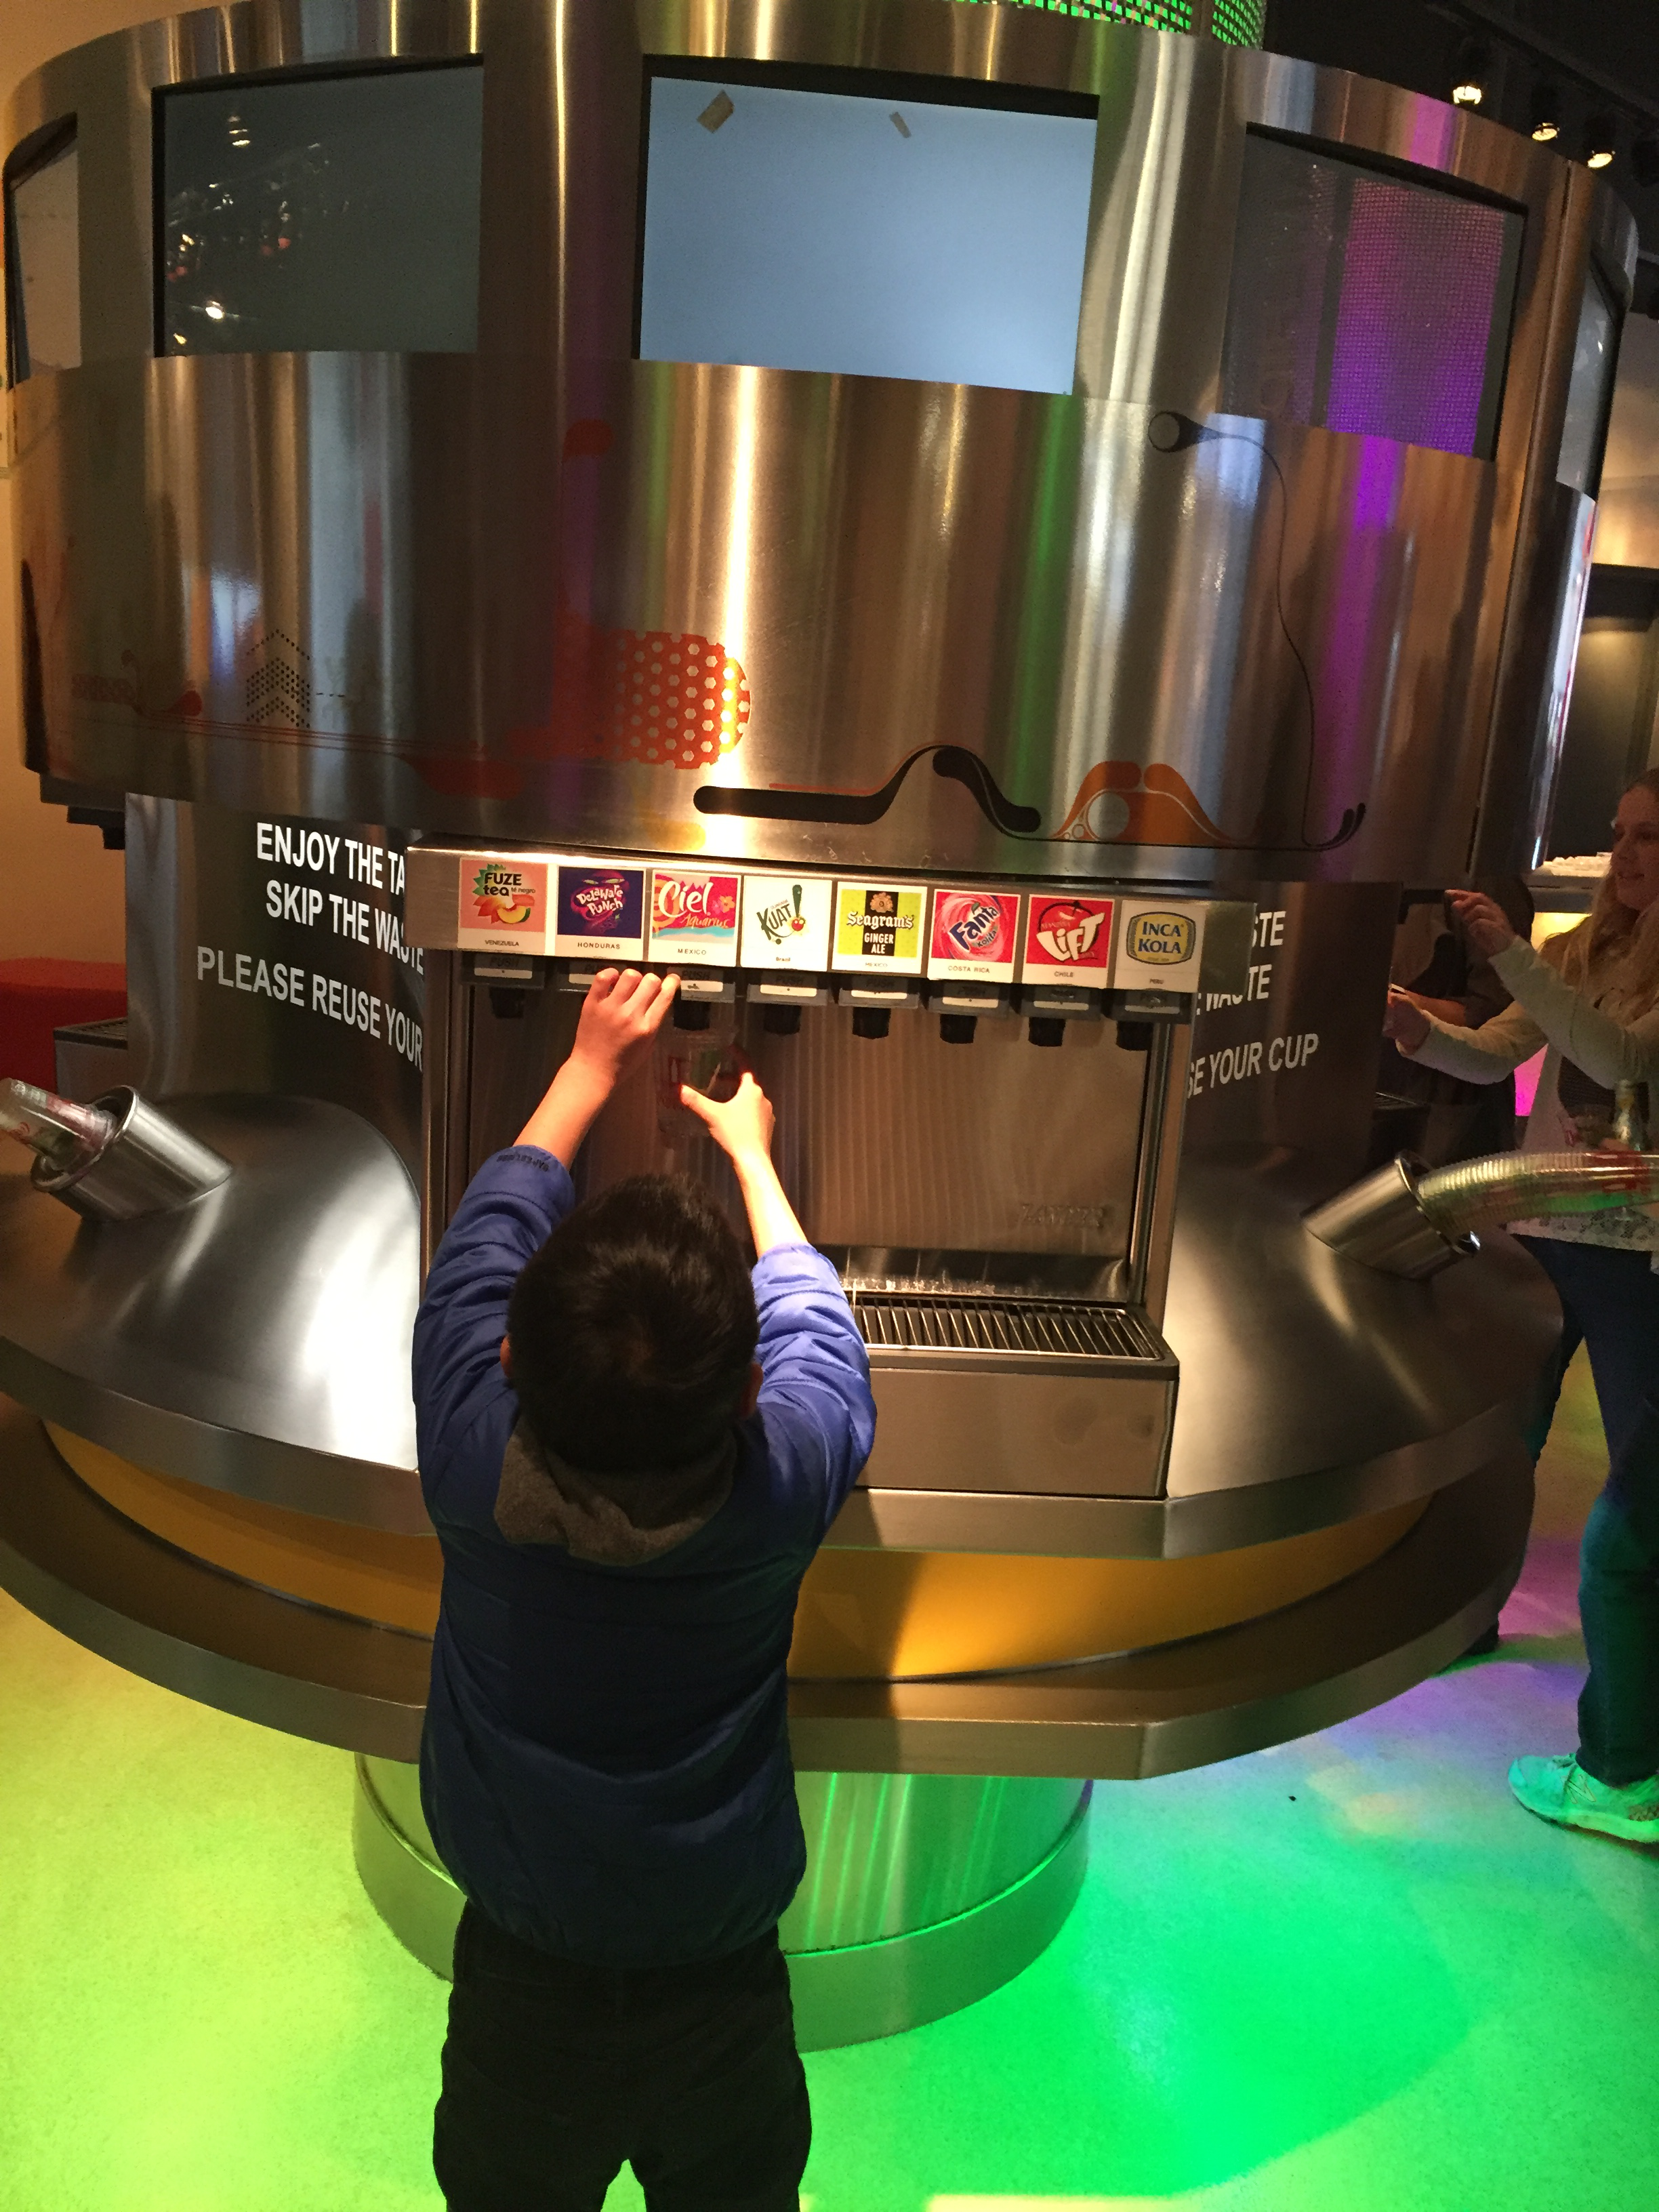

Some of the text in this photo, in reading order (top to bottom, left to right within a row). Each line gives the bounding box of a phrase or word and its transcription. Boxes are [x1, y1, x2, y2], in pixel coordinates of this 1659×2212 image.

[257, 822, 405, 895] ENJOY THE TA
[484, 872, 522, 886] FUZE
[483, 886, 510, 897] tea
[658, 880, 714, 918] Ciel
[266, 880, 323, 927] SKIP
[329, 893, 370, 945] THE
[846, 910, 915, 930] Seagram's
[864, 932, 894, 944] GINGER
[948, 905, 1000, 951] Fanta
[1142, 921, 1181, 937] INCA
[871, 943, 886, 954] ALE
[1138, 938, 1182, 954] KOLA
[197, 945, 422, 1072] PLEASE REUSE YOUR
[1209, 1042, 1263, 1088] YOUR
[1268, 1033, 1319, 1071] CUP
